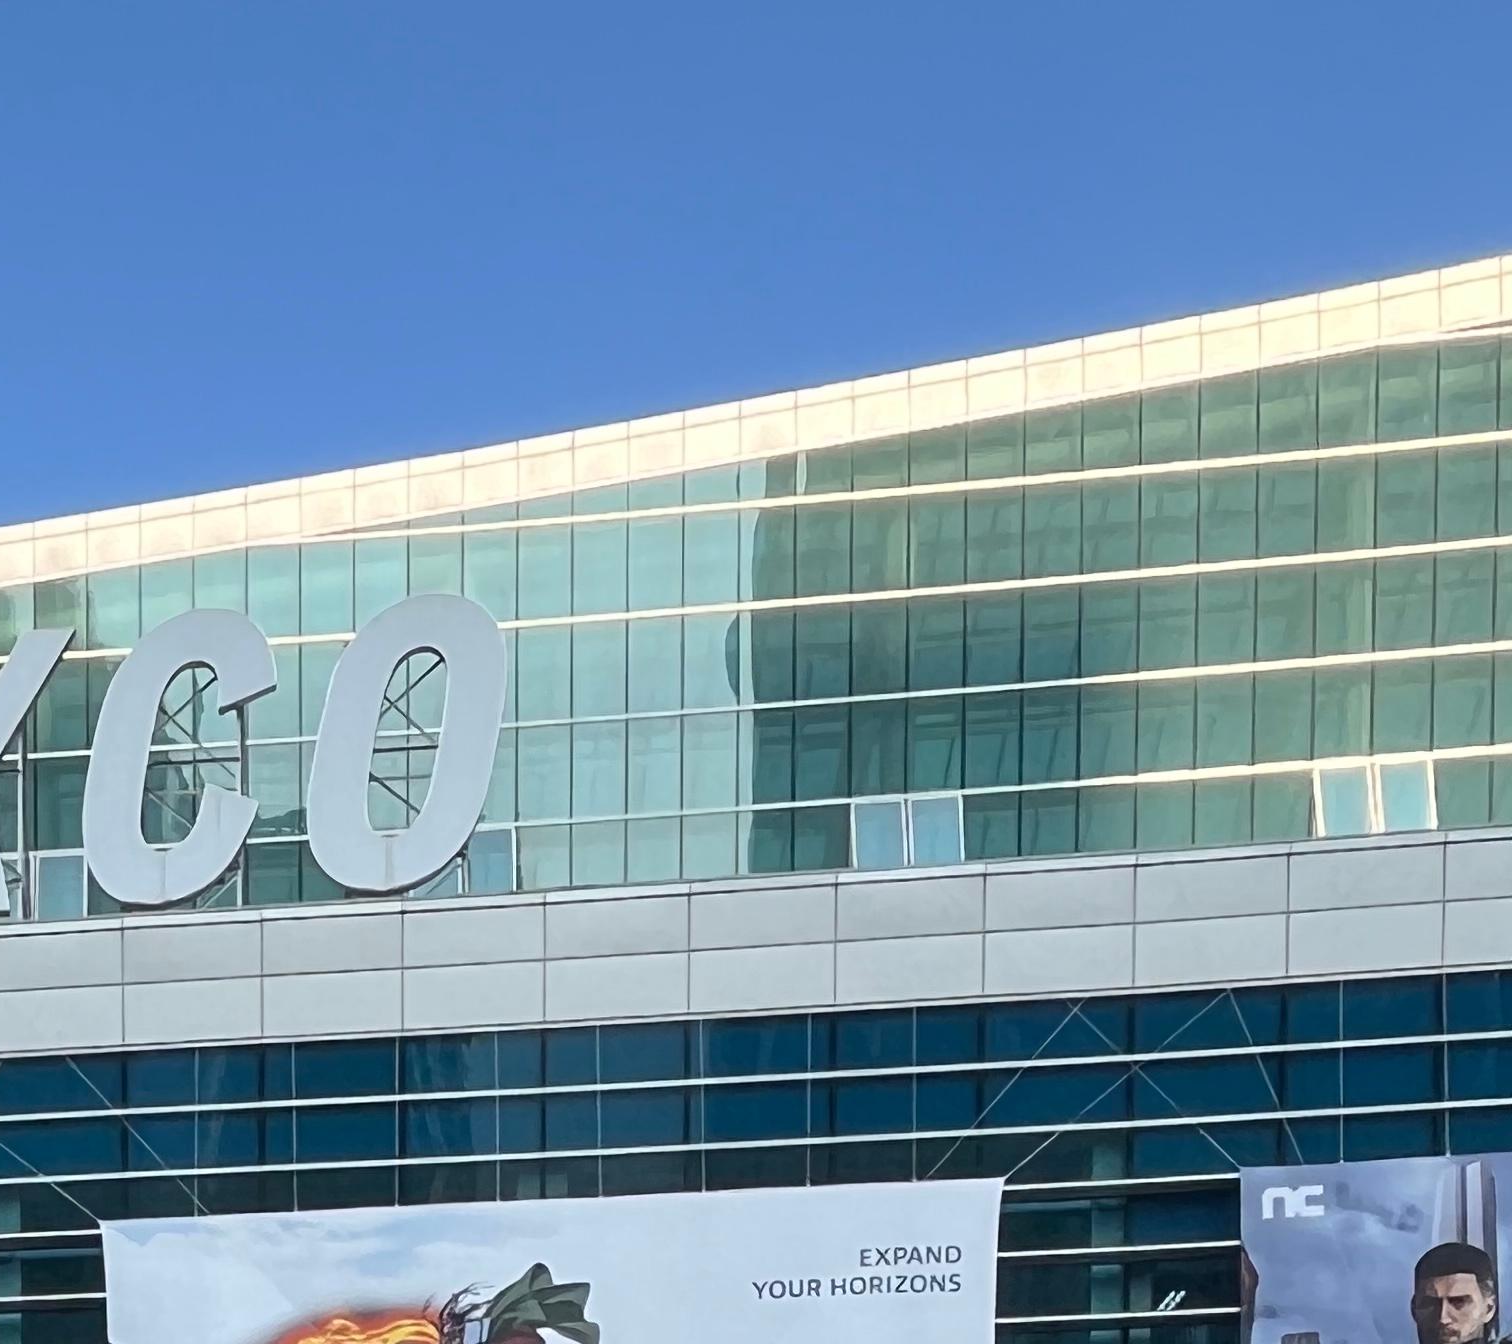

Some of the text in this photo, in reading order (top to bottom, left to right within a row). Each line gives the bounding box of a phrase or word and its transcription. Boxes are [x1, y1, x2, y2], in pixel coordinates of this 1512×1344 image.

[1261, 1184, 1324, 1220] nc
[859, 1245, 962, 1267] EXPAND
[751, 1273, 962, 1299] YOUR HORIZONS
